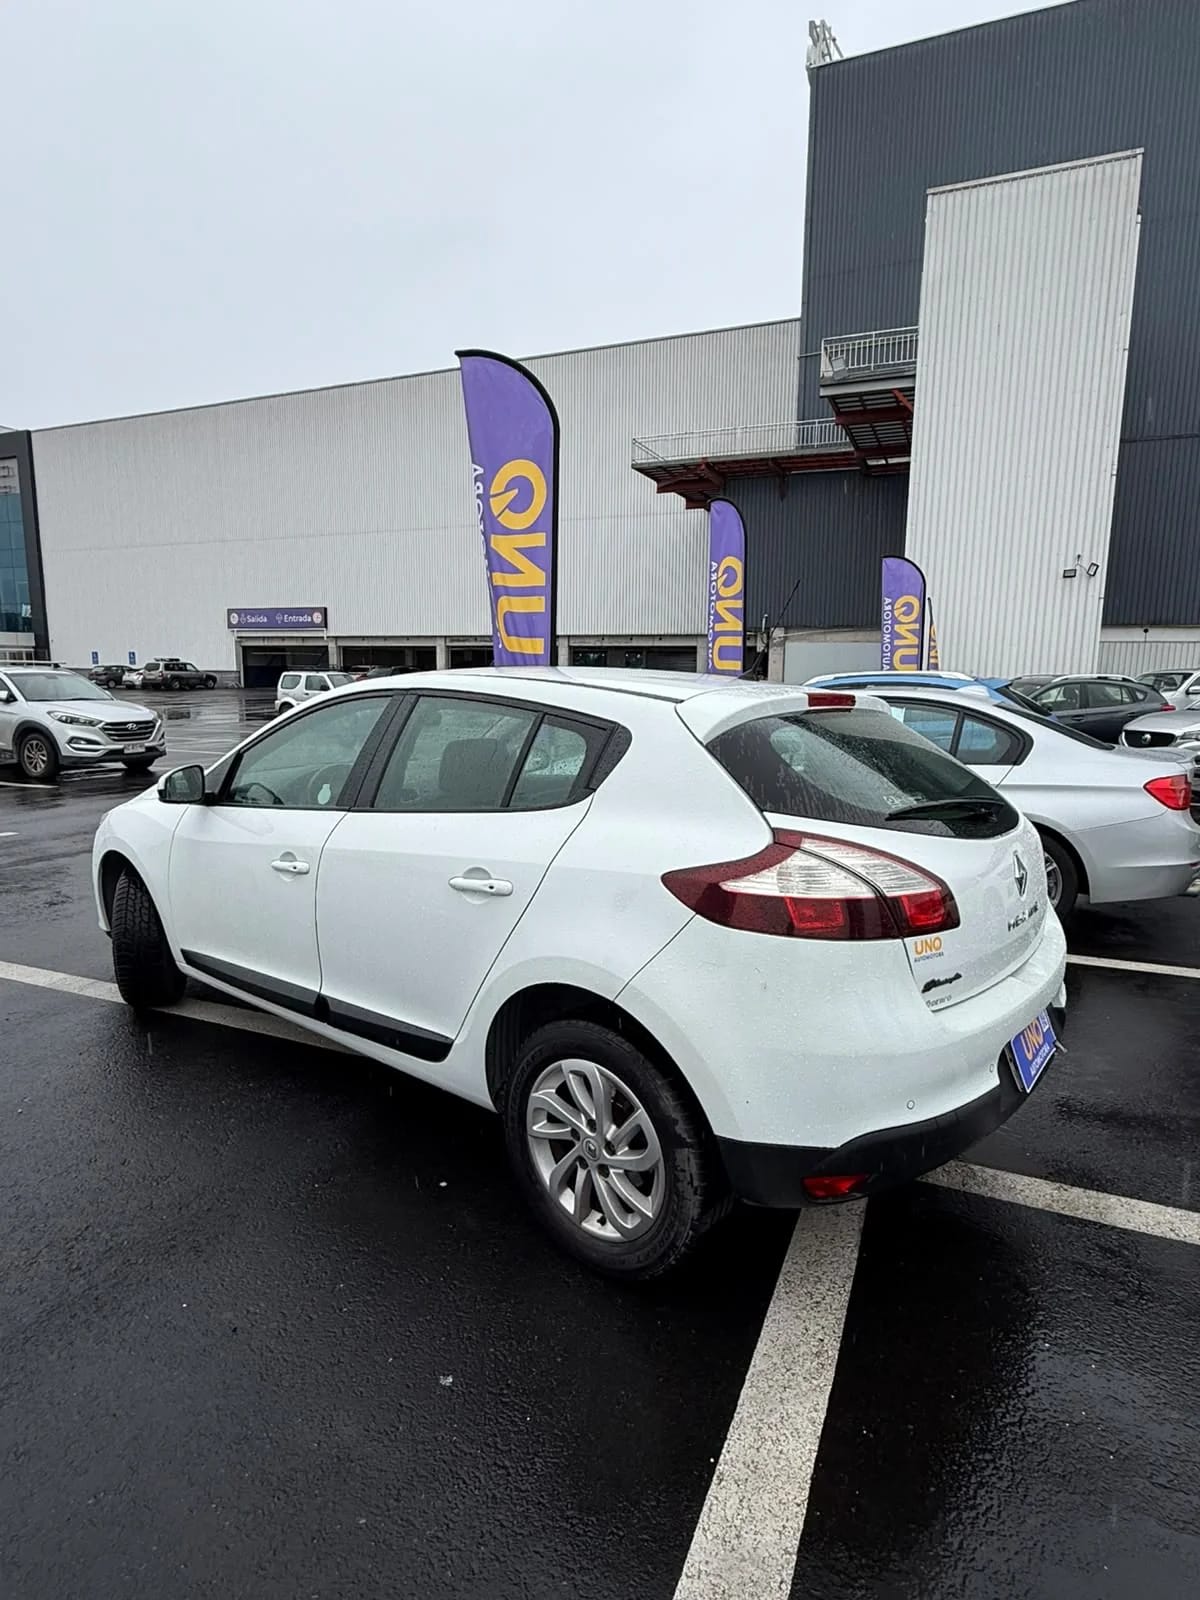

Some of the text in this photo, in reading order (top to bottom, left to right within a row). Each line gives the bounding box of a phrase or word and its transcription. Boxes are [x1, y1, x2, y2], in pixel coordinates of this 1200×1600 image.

[246, 614, 311, 623] Salida Entrada
[914, 936, 943, 955] UNO
[1019, 1018, 1044, 1061] UNO
